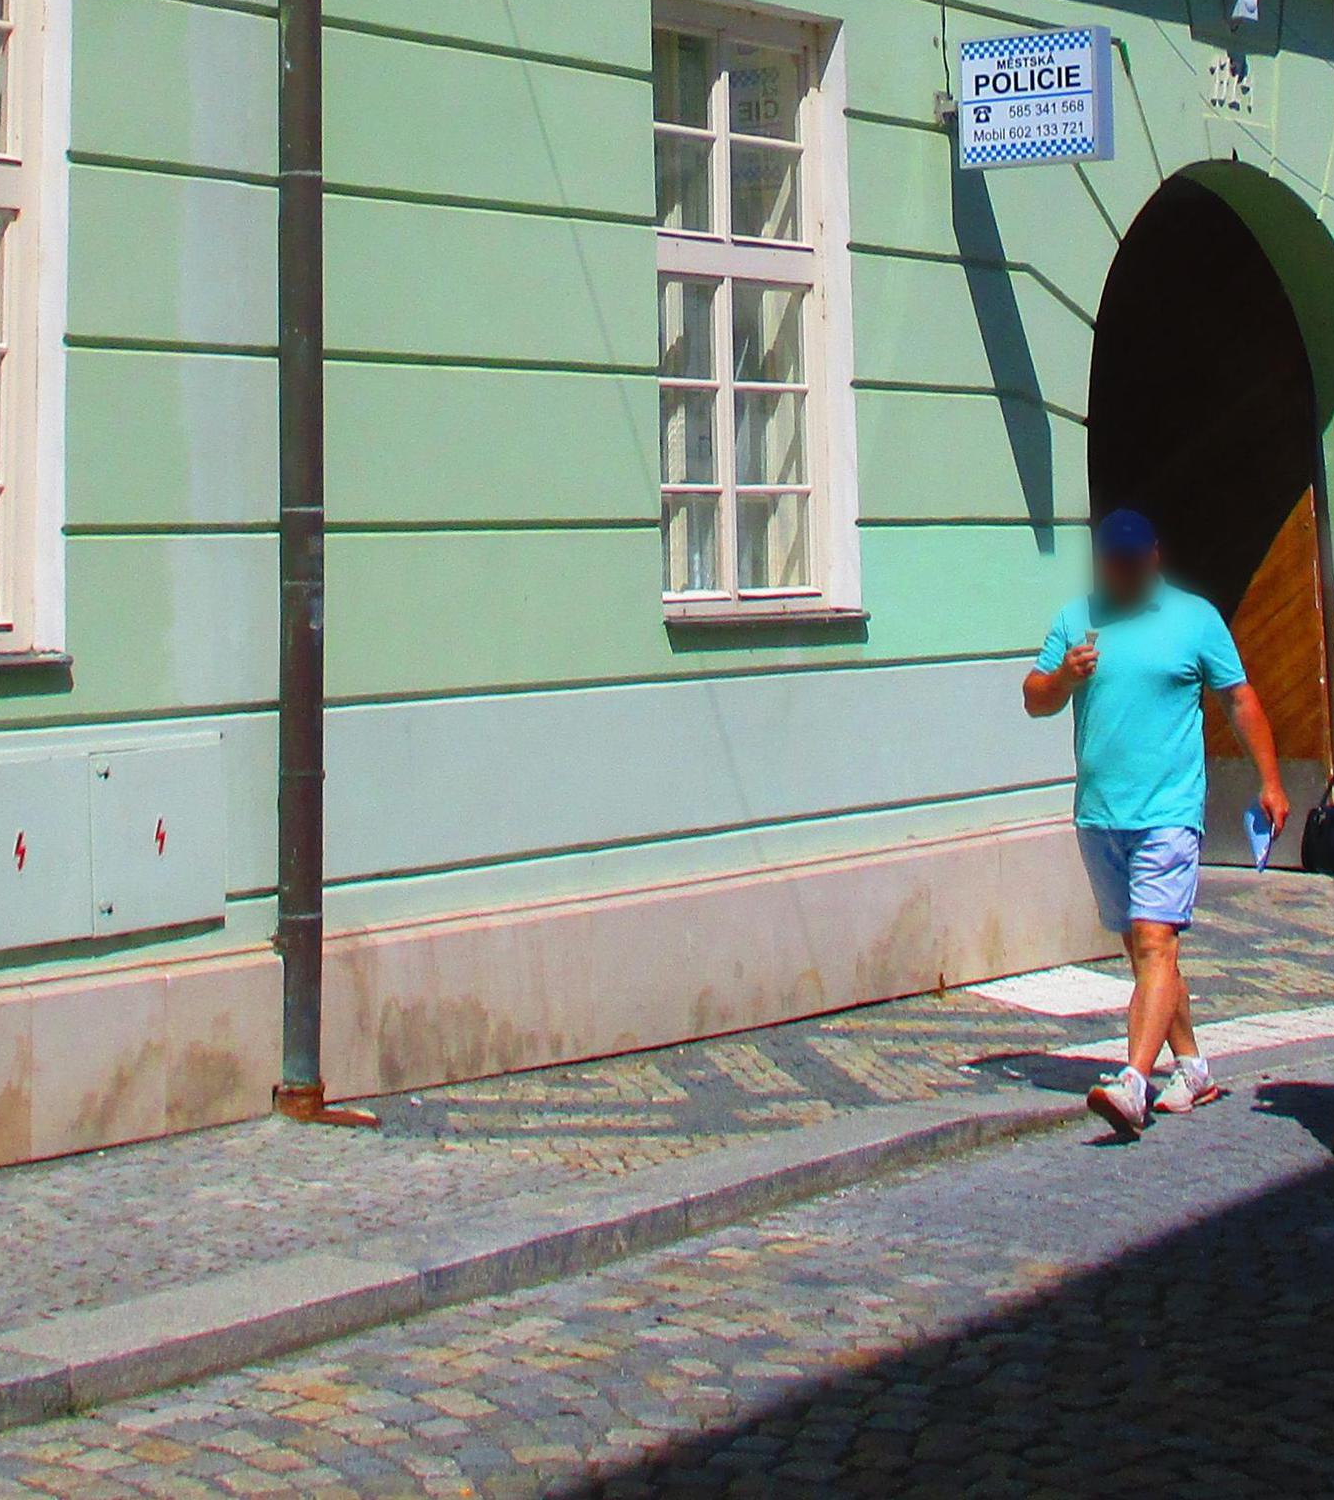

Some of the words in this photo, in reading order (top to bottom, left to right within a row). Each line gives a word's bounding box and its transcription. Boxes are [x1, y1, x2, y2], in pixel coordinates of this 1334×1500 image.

[996, 52, 1055, 70] MĚSTSKÁ
[974, 64, 1081, 97] POLICIE
[1009, 104, 1032, 119] 585
[1035, 102, 1057, 117] 341
[1061, 99, 1085, 114] 568
[973, 127, 1006, 143] Mobil
[1009, 125, 1032, 140] 602
[1036, 123, 1058, 137] 133
[1062, 121, 1085, 136] 721
